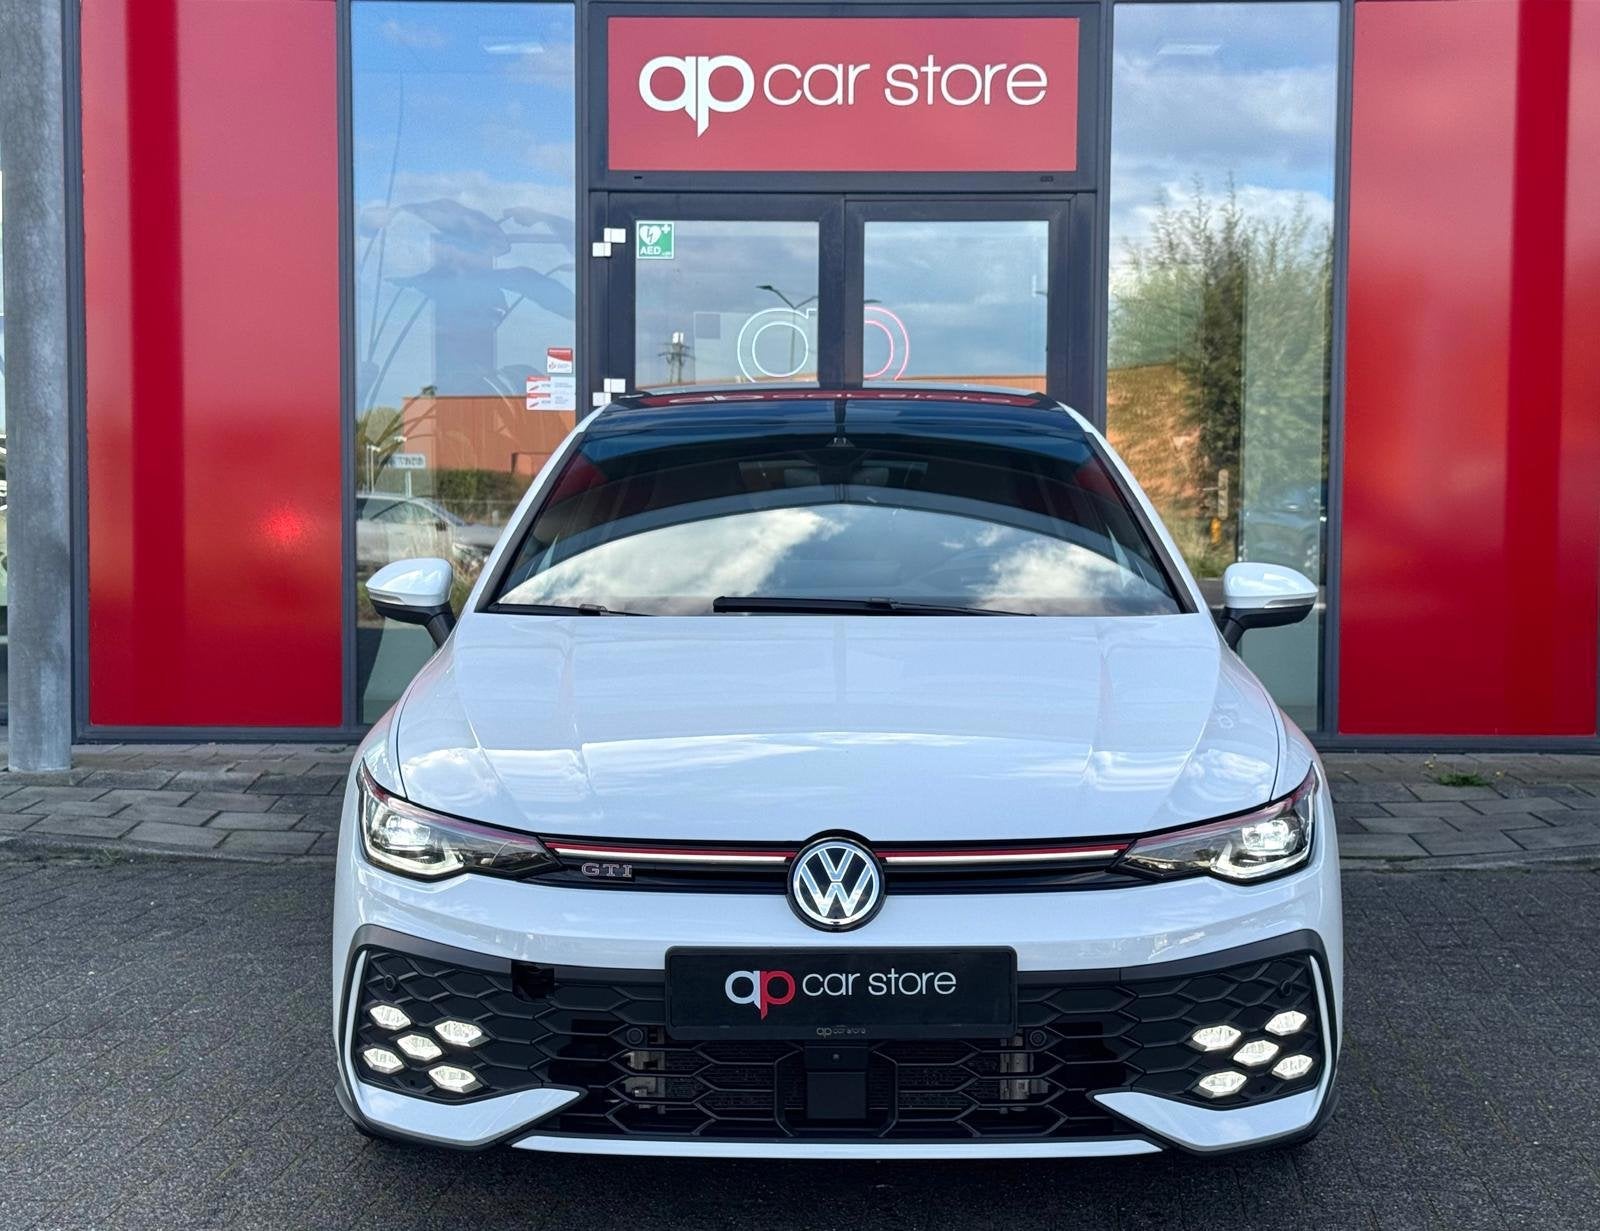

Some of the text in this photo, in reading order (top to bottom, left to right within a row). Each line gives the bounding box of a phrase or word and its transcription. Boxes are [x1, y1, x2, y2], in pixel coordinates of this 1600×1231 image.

[763, 63, 871, 106] car
[884, 54, 1048, 106] store
[639, 246, 662, 255] AED
[581, 862, 633, 878] GTI
[802, 971, 861, 996] car
[867, 967, 957, 996] store
